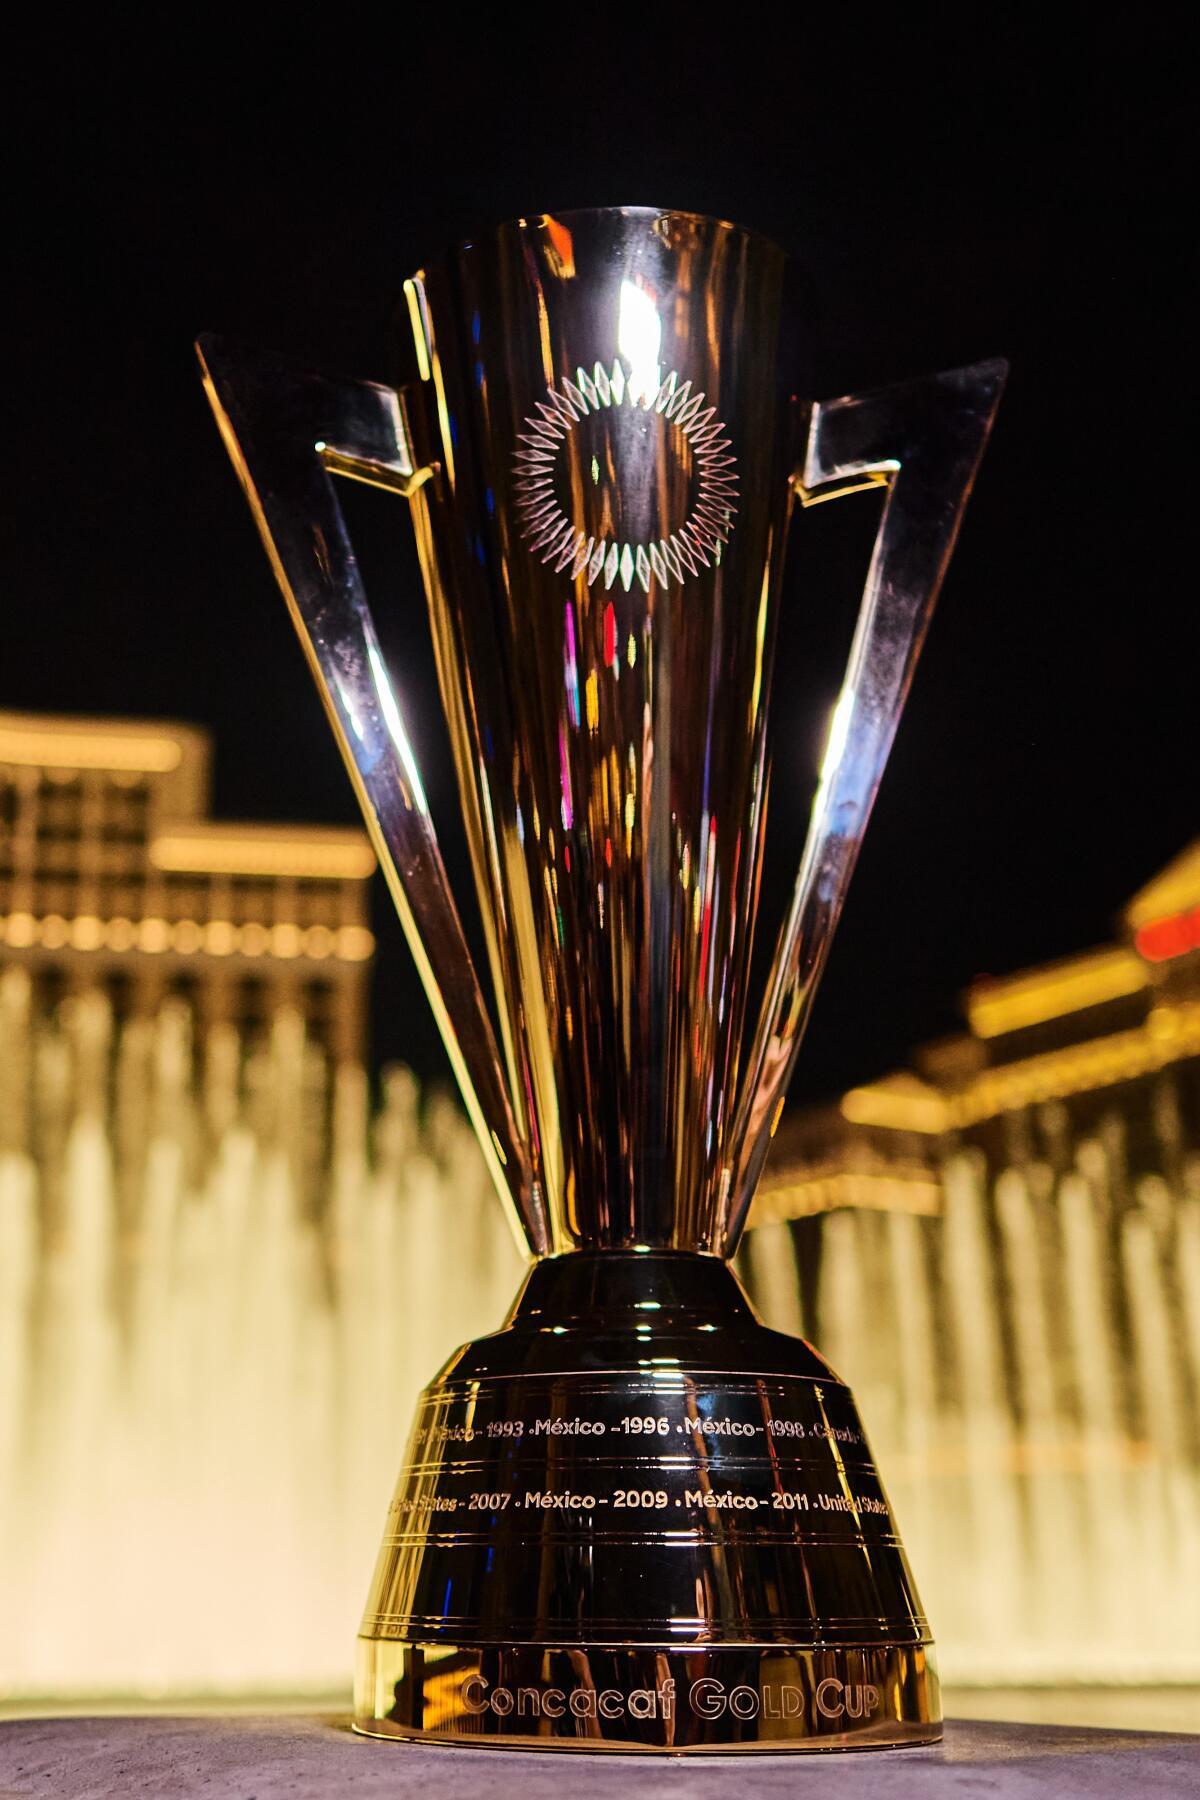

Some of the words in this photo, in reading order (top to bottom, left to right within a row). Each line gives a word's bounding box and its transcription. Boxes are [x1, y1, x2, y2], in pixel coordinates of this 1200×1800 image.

[486, 1420, 525, 1438] 1993
[766, 1419, 806, 1439] 1998
[468, 1492, 512, 1510] 2007
[612, 1490, 669, 1509] 2009
[771, 1492, 809, 1511] 2011
[460, 1673, 675, 1720] Concacaf
